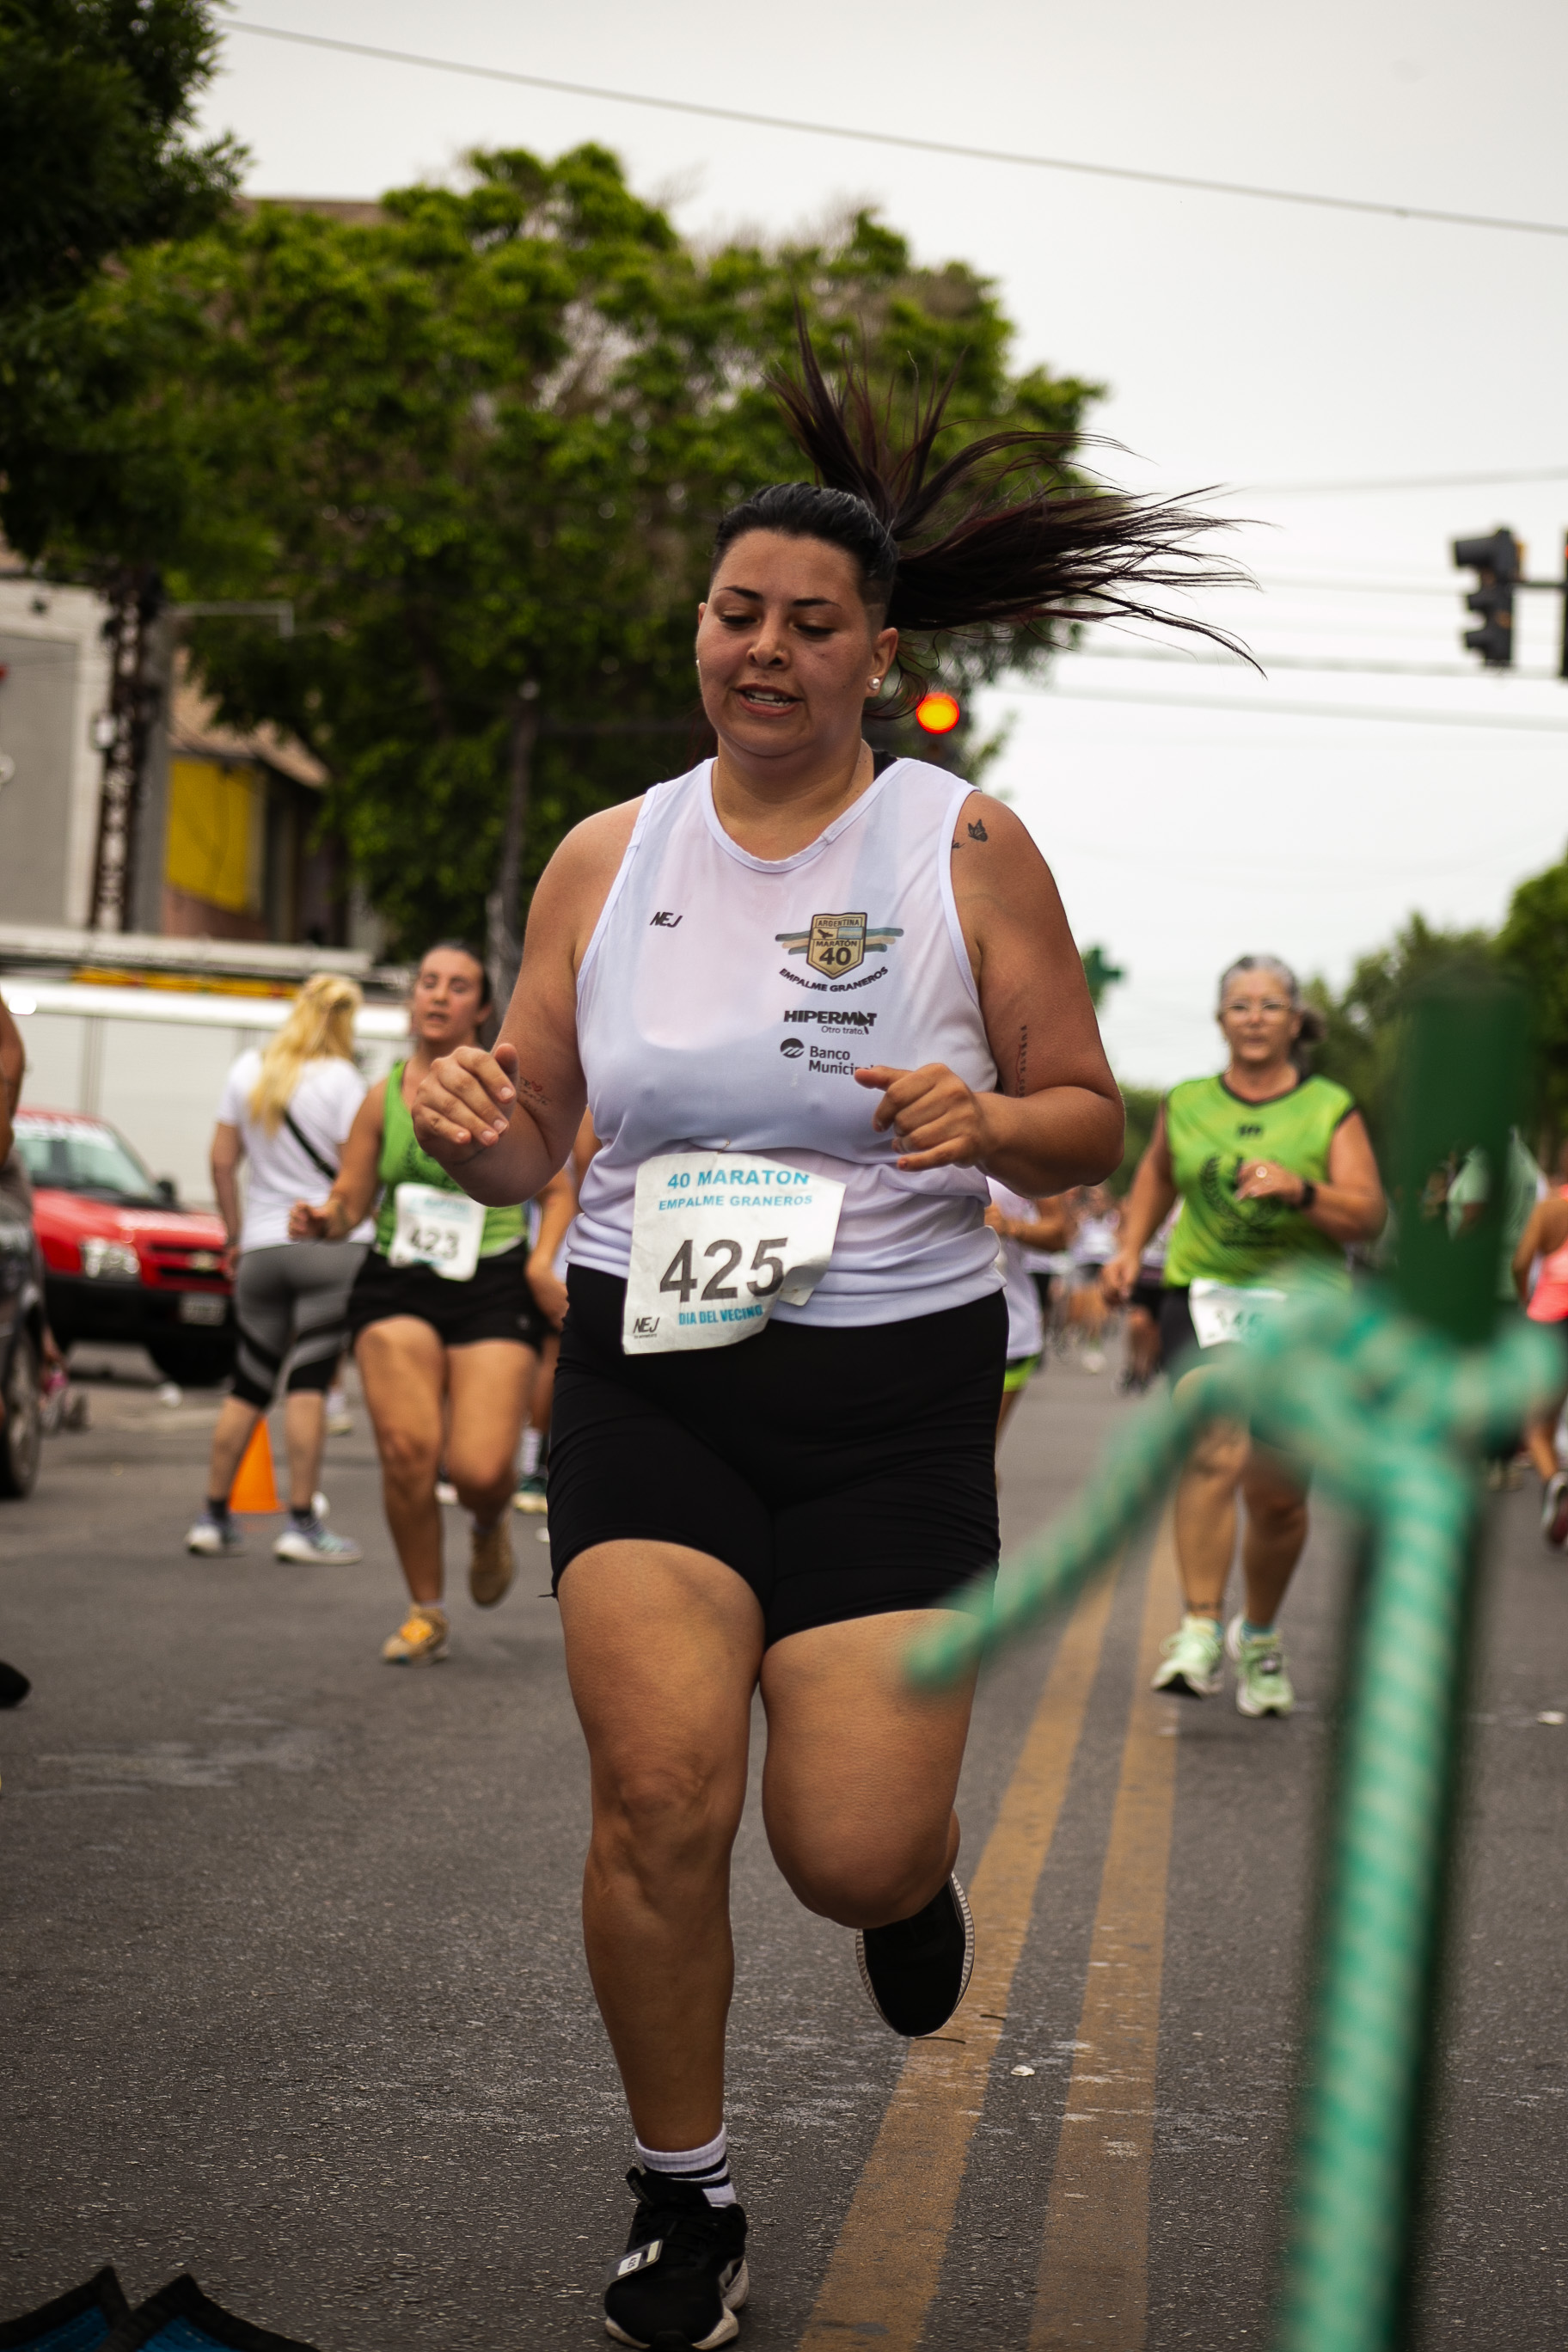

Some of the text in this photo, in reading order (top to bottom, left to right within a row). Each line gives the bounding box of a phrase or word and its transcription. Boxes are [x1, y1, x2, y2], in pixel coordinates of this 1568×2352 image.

[818, 919, 860, 928] ARGENTINA
[816, 940, 858, 948] MARATÓN
[819, 947, 852, 966] 40
[779, 966, 889, 992] EMPALME GRANEROS
[821, 1025, 841, 1034] Otro
[810, 1045, 850, 1061] Banco
[667, 1169, 810, 1189] 40 MARATON
[658, 1195, 812, 1210] EMPALME GRANEROS
[658, 1237, 789, 1302] 425
[678, 1304, 764, 1326] DIA DEL VECINO
[633, 1316, 660, 1333] NEJ
